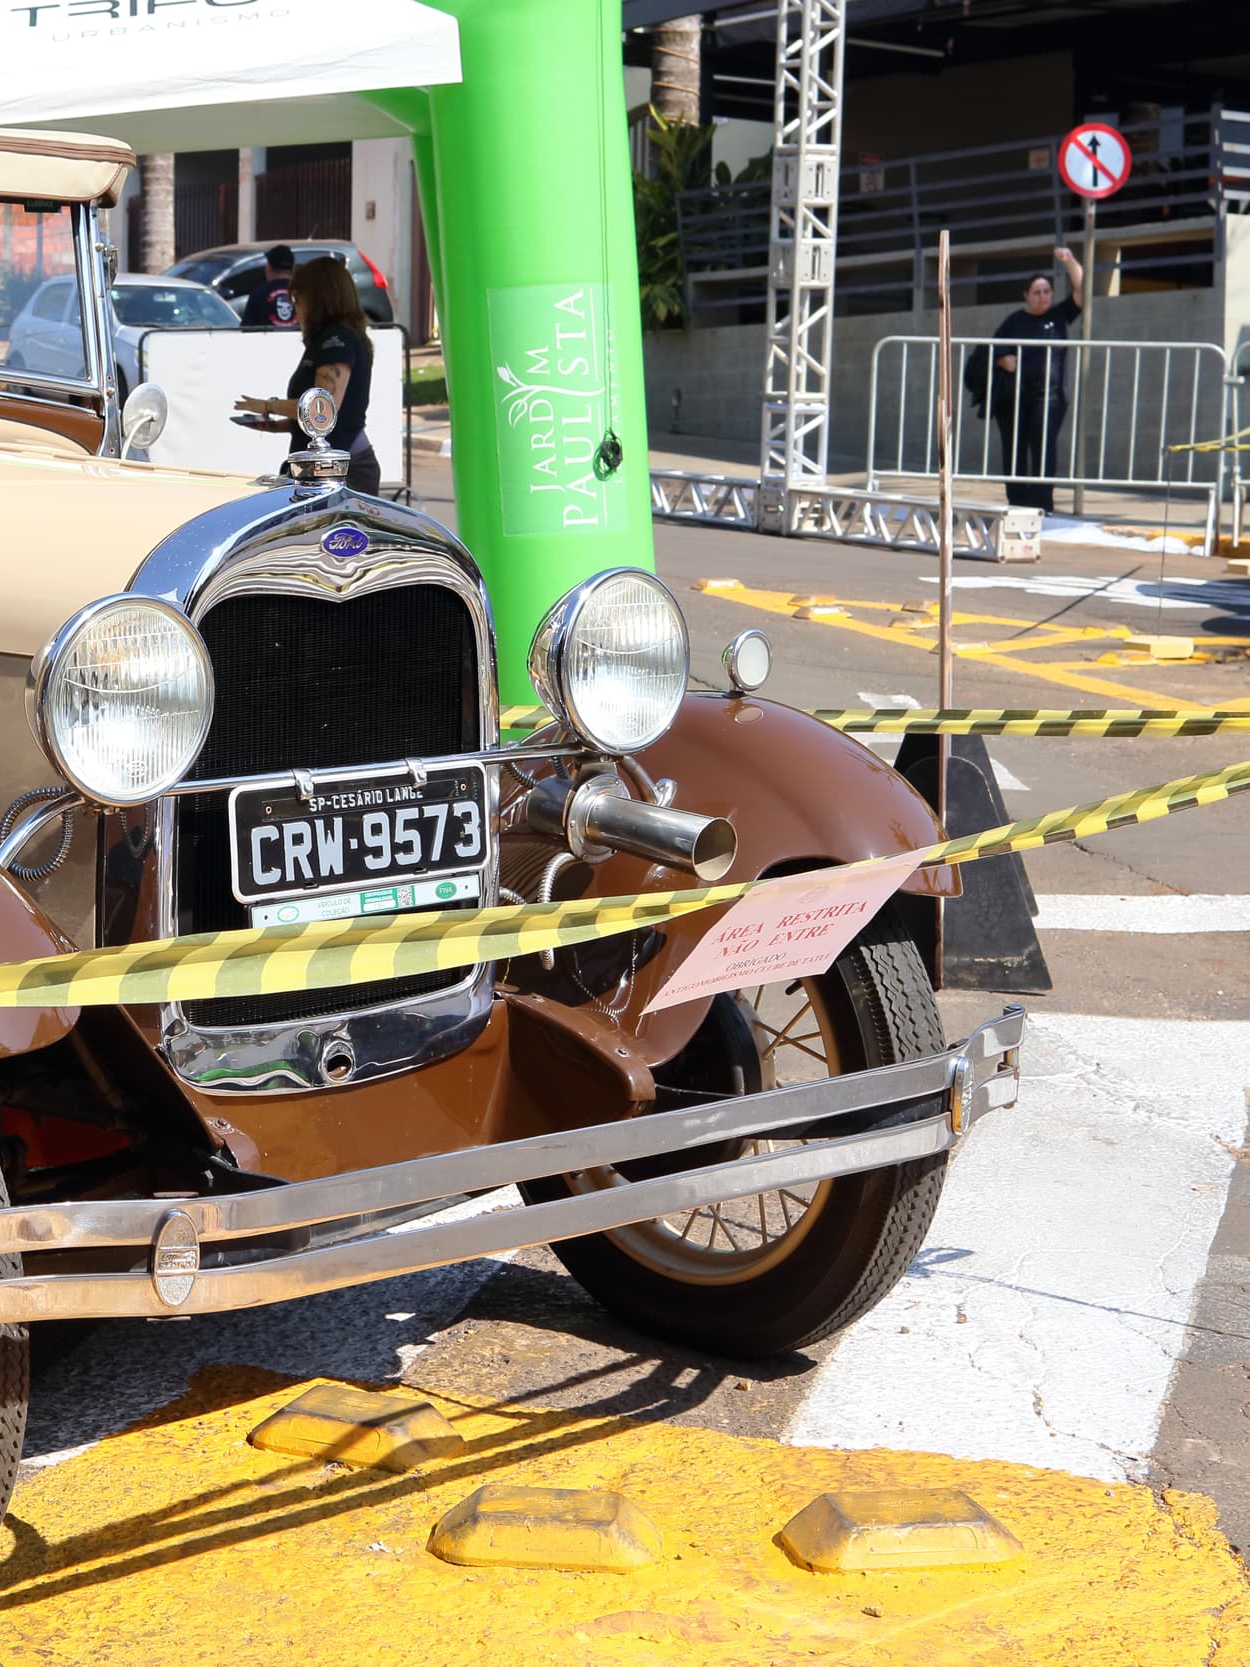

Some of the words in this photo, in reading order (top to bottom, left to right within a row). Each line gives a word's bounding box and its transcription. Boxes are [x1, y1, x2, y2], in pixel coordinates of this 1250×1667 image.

[52, 9, 290, 42] URBANISMO
[553, 288, 599, 528] PAULISTA
[328, 532, 364, 550] Ford
[712, 921, 765, 945] ÁREA
[776, 900, 868, 929] RESTRITA
[717, 939, 759, 958] NÃO
[767, 923, 835, 946] ENTRE
[725, 952, 787, 973] OBRIGADO
